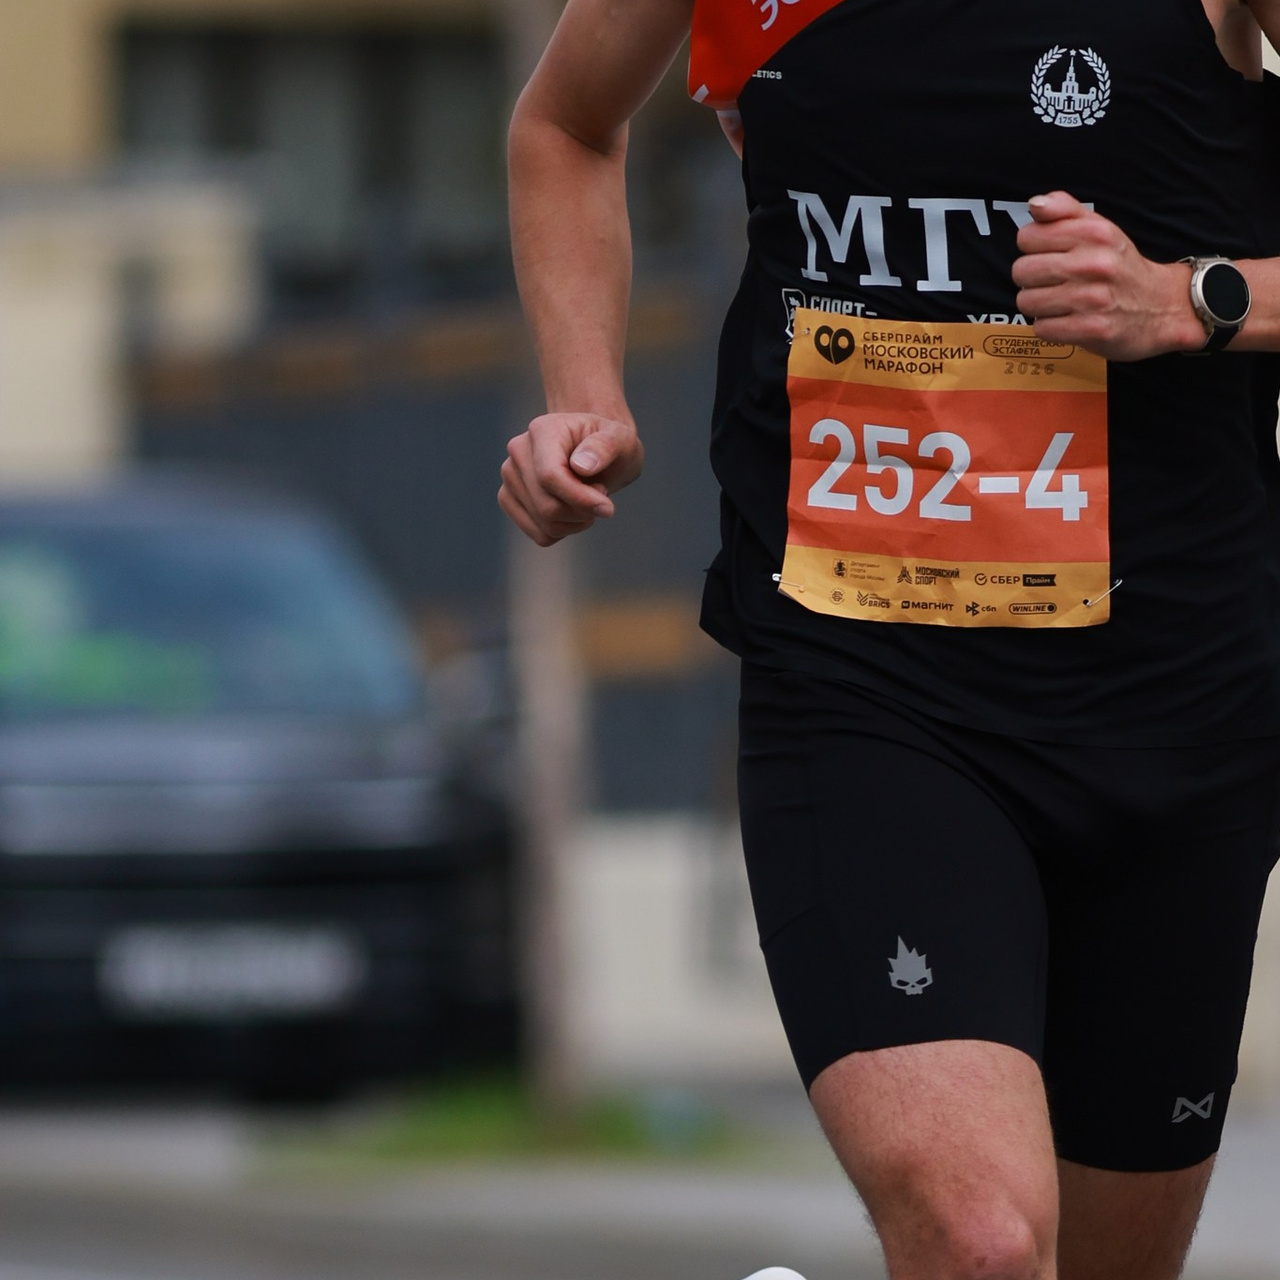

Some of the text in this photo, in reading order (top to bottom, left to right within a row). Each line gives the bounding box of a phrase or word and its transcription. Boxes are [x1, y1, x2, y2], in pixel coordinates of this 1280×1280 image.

[1058, 116, 1078, 125] 1755
[863, 331, 943, 345] СБЕРПРАЙМ
[863, 343, 974, 360] МОСКОВСКИЙ
[992, 346, 1041, 356] ЭСТАФЕТА
[864, 358, 943, 374] МАРАФОН
[1004, 361, 1055, 375] 2026
[807, 418, 1089, 521] 252-4
[915, 575, 937, 586] СПОРТ
[990, 575, 1021, 584] СБЕР
[868, 600, 891, 609] BRICS
[911, 601, 955, 611] магнит
[981, 604, 997, 612] сбп
[1012, 604, 1047, 613] WINLINE
